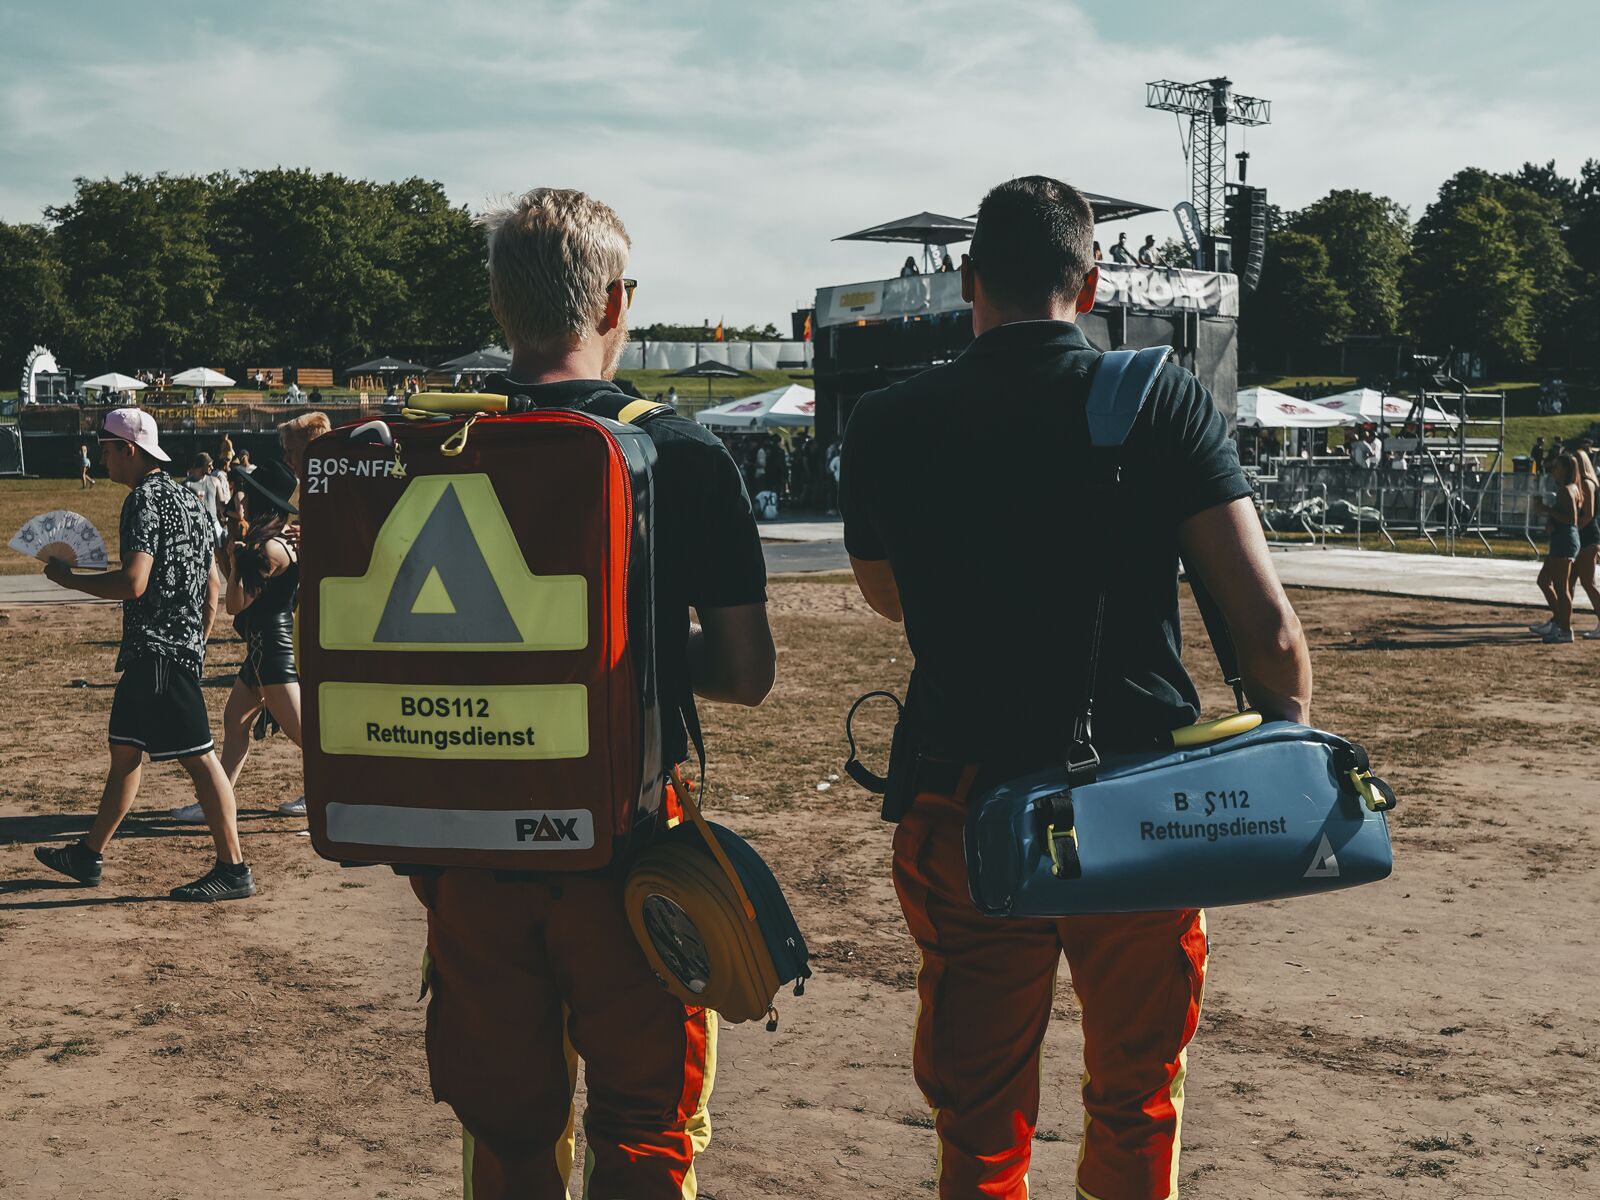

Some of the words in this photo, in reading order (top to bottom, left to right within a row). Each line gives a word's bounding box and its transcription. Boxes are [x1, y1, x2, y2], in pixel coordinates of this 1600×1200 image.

[168, 407, 238, 418] EXPERIENCE
[308, 477, 329, 494] 21
[401, 696, 490, 718] BOS112
[366, 722, 535, 750] Rettungsdienst
[515, 813, 580, 842] PAX
[1140, 816, 1287, 842] Rettungsdienst
